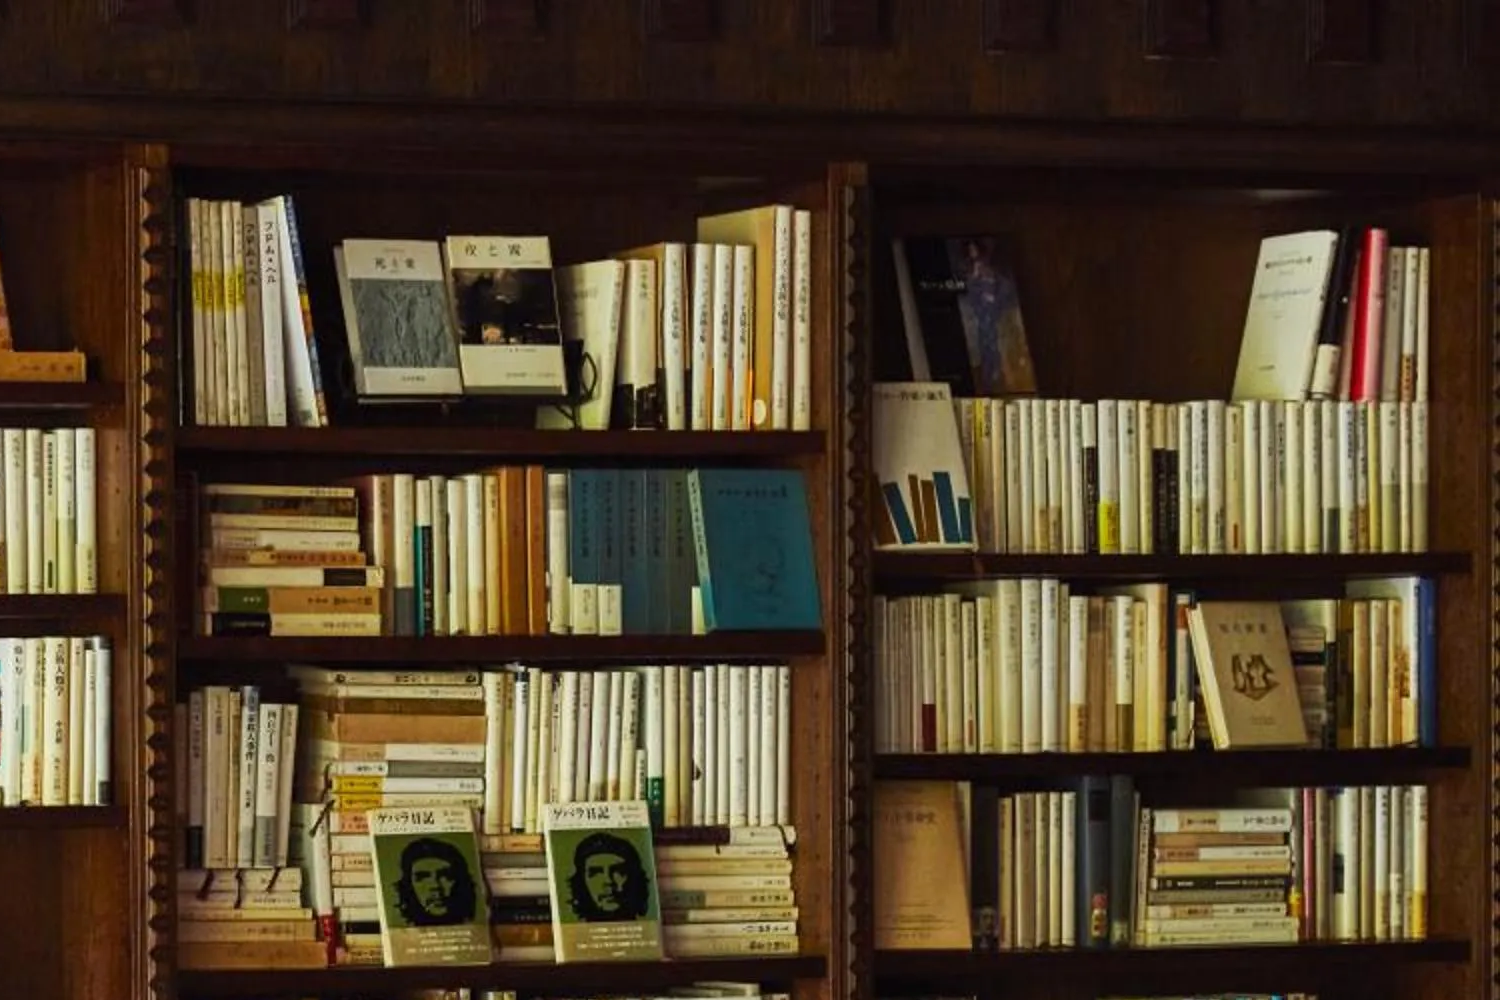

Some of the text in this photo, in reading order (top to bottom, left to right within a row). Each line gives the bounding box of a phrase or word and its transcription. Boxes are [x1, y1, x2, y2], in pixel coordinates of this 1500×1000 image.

[376, 811, 435, 826] ゲバラ日記
[552, 805, 611, 821] ゲバラ日記
